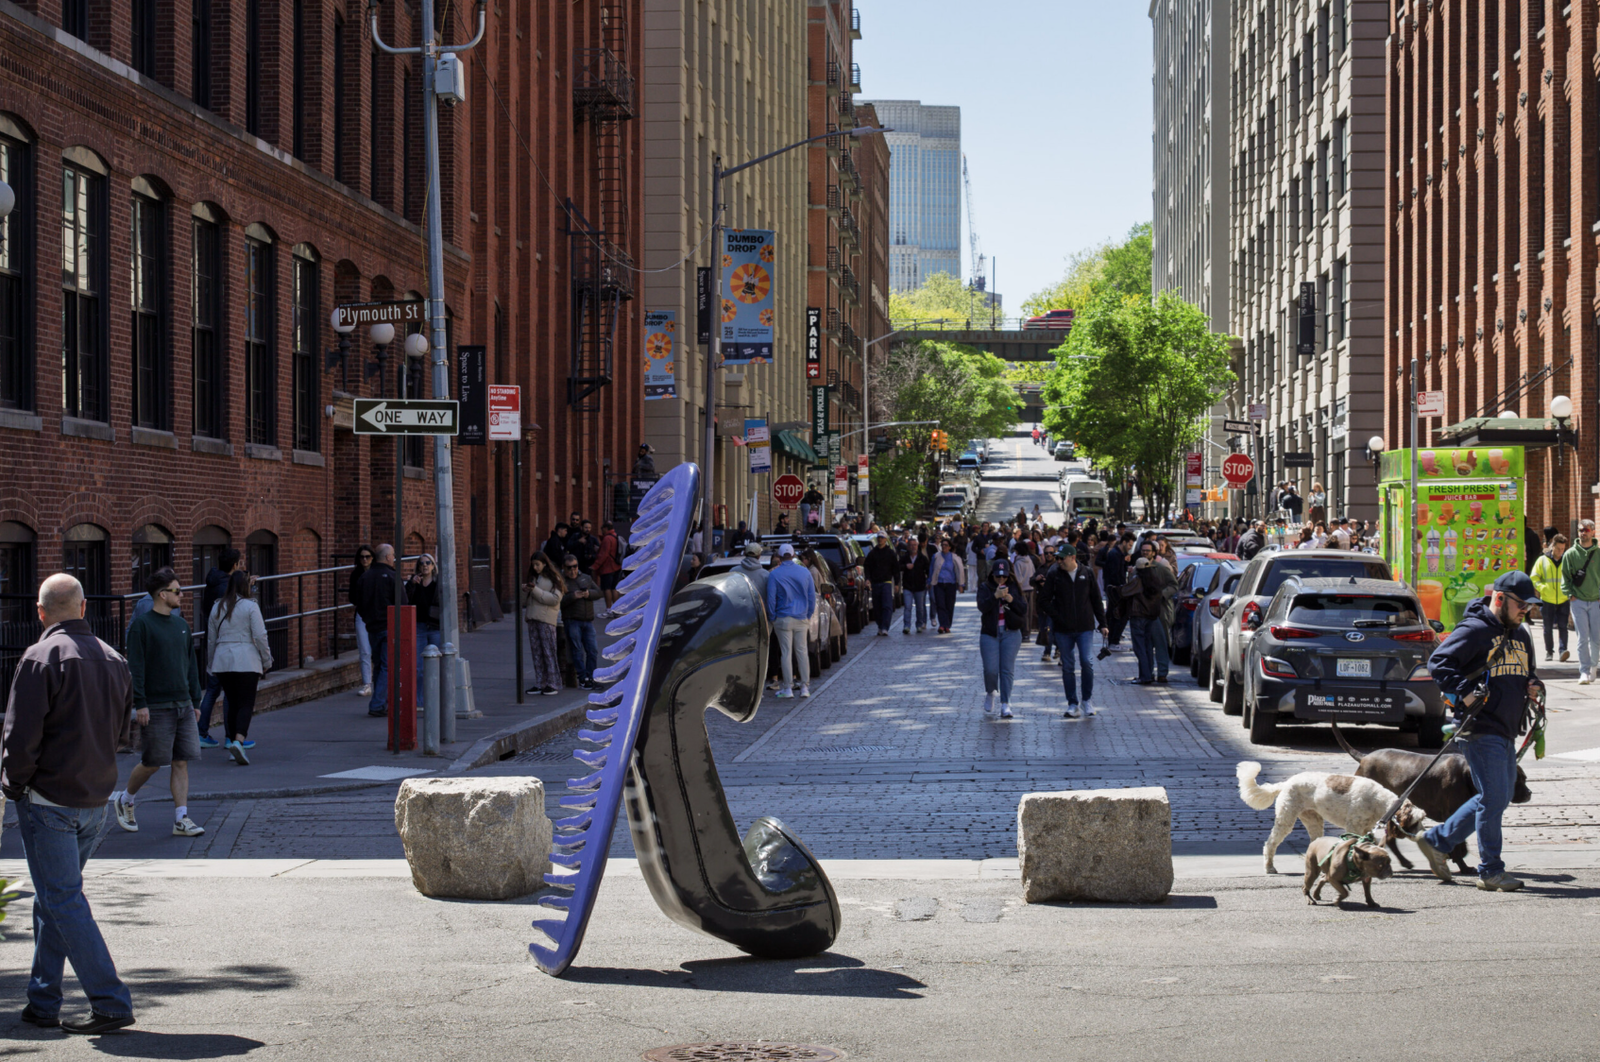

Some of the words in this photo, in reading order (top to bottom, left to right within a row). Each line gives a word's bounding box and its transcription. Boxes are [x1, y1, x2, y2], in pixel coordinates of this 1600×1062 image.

[727, 234, 764, 244] DUMBO
[727, 244, 757, 253] DROP
[339, 304, 401, 326] Plymouth
[405, 304, 418, 319] St
[809, 315, 818, 359] PARK
[460, 352, 470, 374] Space
[462, 375, 469, 384] to
[462, 385, 470, 402] Live
[374, 410, 402, 424] ONE
[416, 411, 447, 424] WAY
[1224, 462, 1252, 476] STOP
[775, 484, 802, 497] STOP
[1428, 485, 1460, 493] FRESH
[1463, 484, 1495, 493] PRESS
[714, 536, 721, 545] P
[1308, 694, 1326, 706] Plaza
